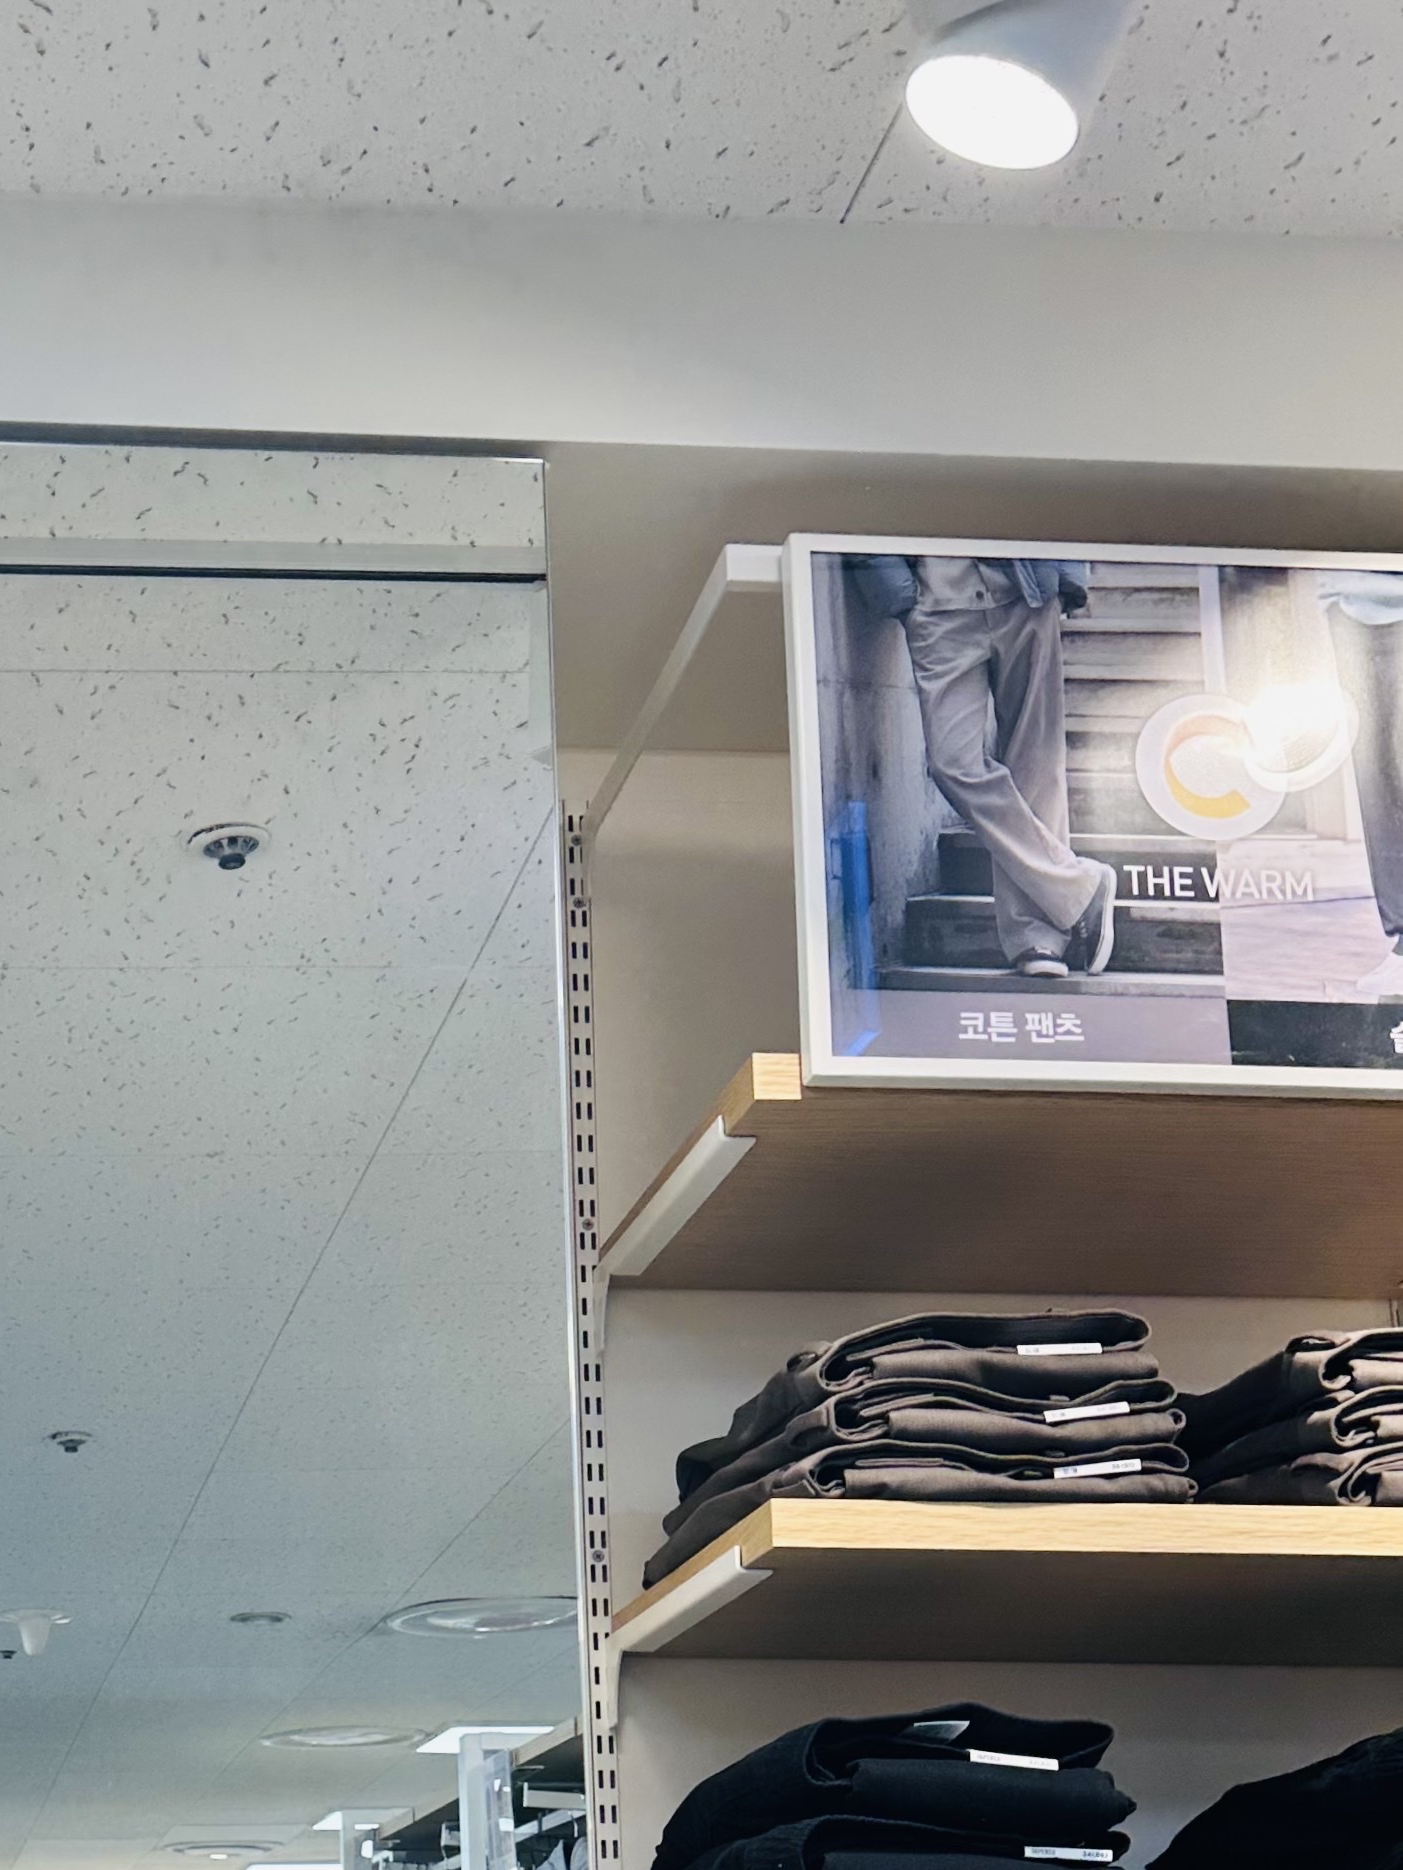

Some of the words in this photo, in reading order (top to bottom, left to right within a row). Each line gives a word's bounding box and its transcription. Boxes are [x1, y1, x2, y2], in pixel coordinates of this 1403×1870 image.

[1123, 864, 1194, 898] THE
[1202, 867, 1314, 902] WARM
[958, 1010, 1018, 1044] 코튼
[1025, 1012, 1085, 1045] 팬츠
